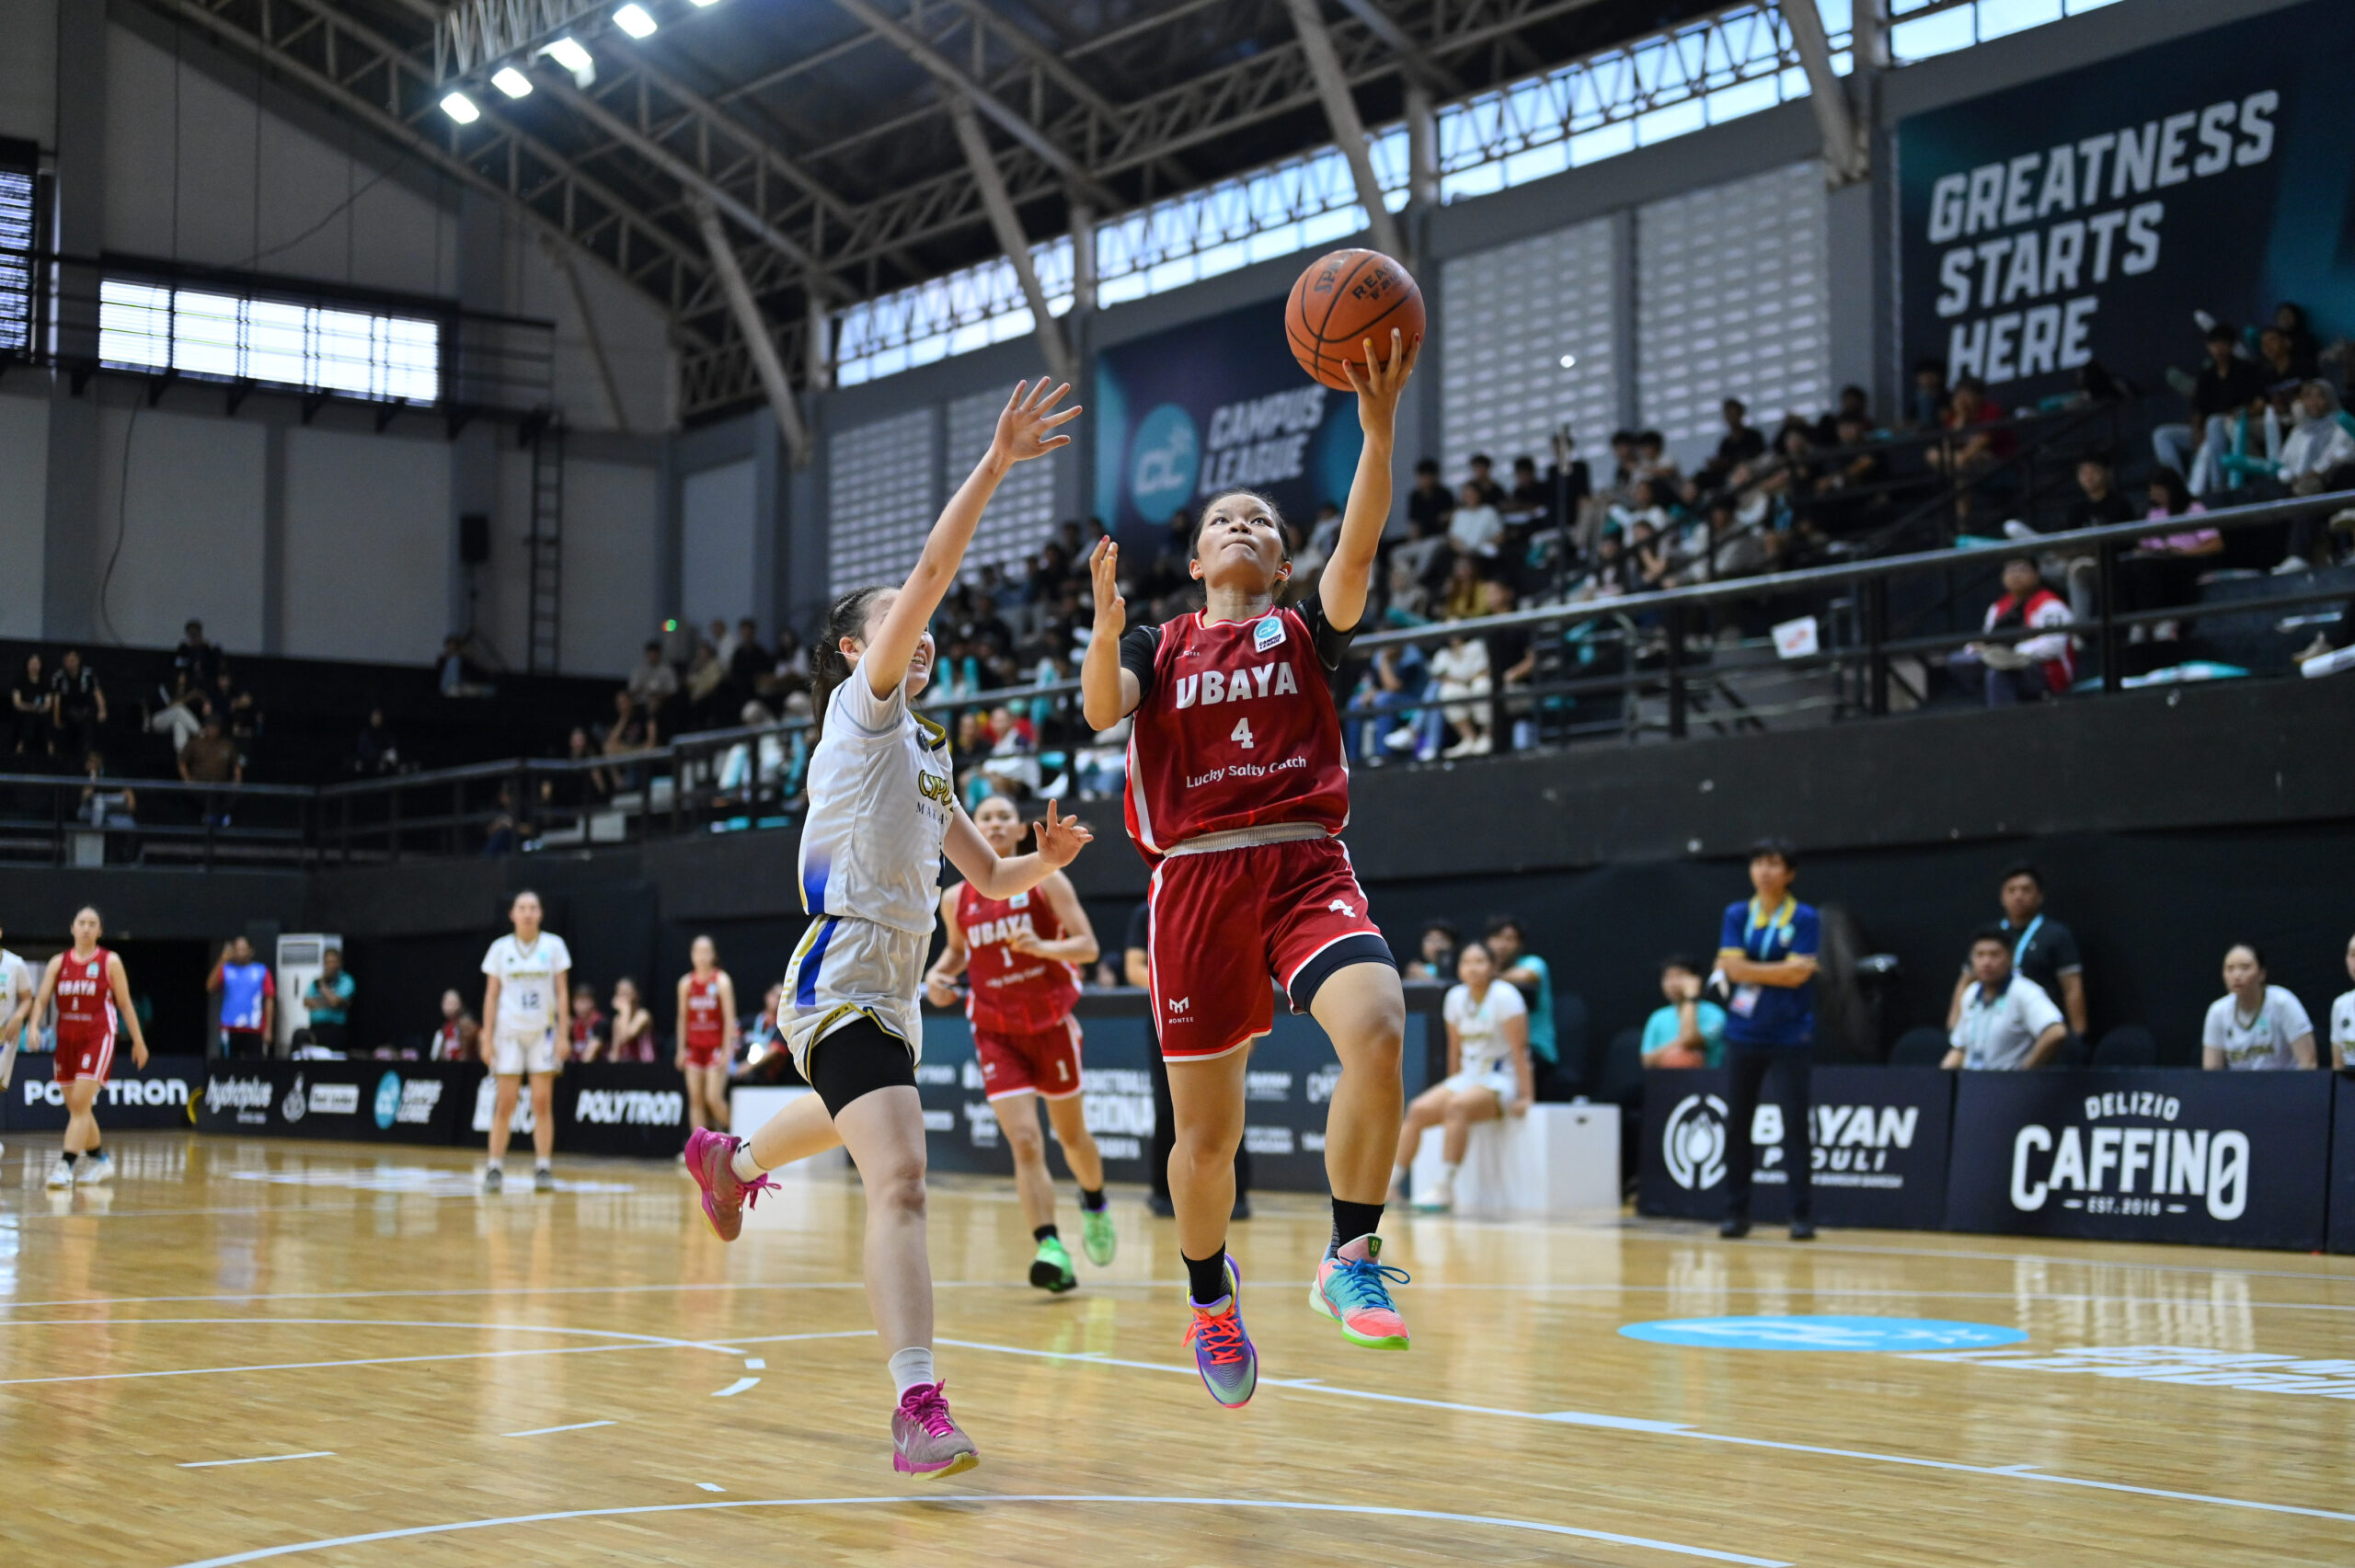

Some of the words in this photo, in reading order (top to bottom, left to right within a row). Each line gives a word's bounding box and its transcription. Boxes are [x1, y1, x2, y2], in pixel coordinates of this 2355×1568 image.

[1927, 90, 2280, 244] GREATNESS
[1936, 200, 2165, 318] STARTS
[1946, 294, 2099, 393] HERE
[1208, 383, 1329, 452] CAMPUS
[1200, 433, 1311, 498] LEAGUE
[1258, 633, 1282, 647] CAMPUS
[1177, 661, 1298, 709] UBAYA
[1230, 717, 1255, 749] 4
[1186, 767, 1225, 788] Lucky
[1228, 764, 1266, 777] Salty
[1269, 755, 1307, 774] Catch
[967, 912, 1034, 948] UBAYA
[1001, 946, 1014, 967] 1
[1056, 1059, 1070, 1082] 1
[24, 1078, 189, 1105] POTRON
[575, 1089, 684, 1126] POLYTRON
[2085, 1091, 2180, 1122] DELIZIO
[1751, 1104, 1919, 1149] BYAN
